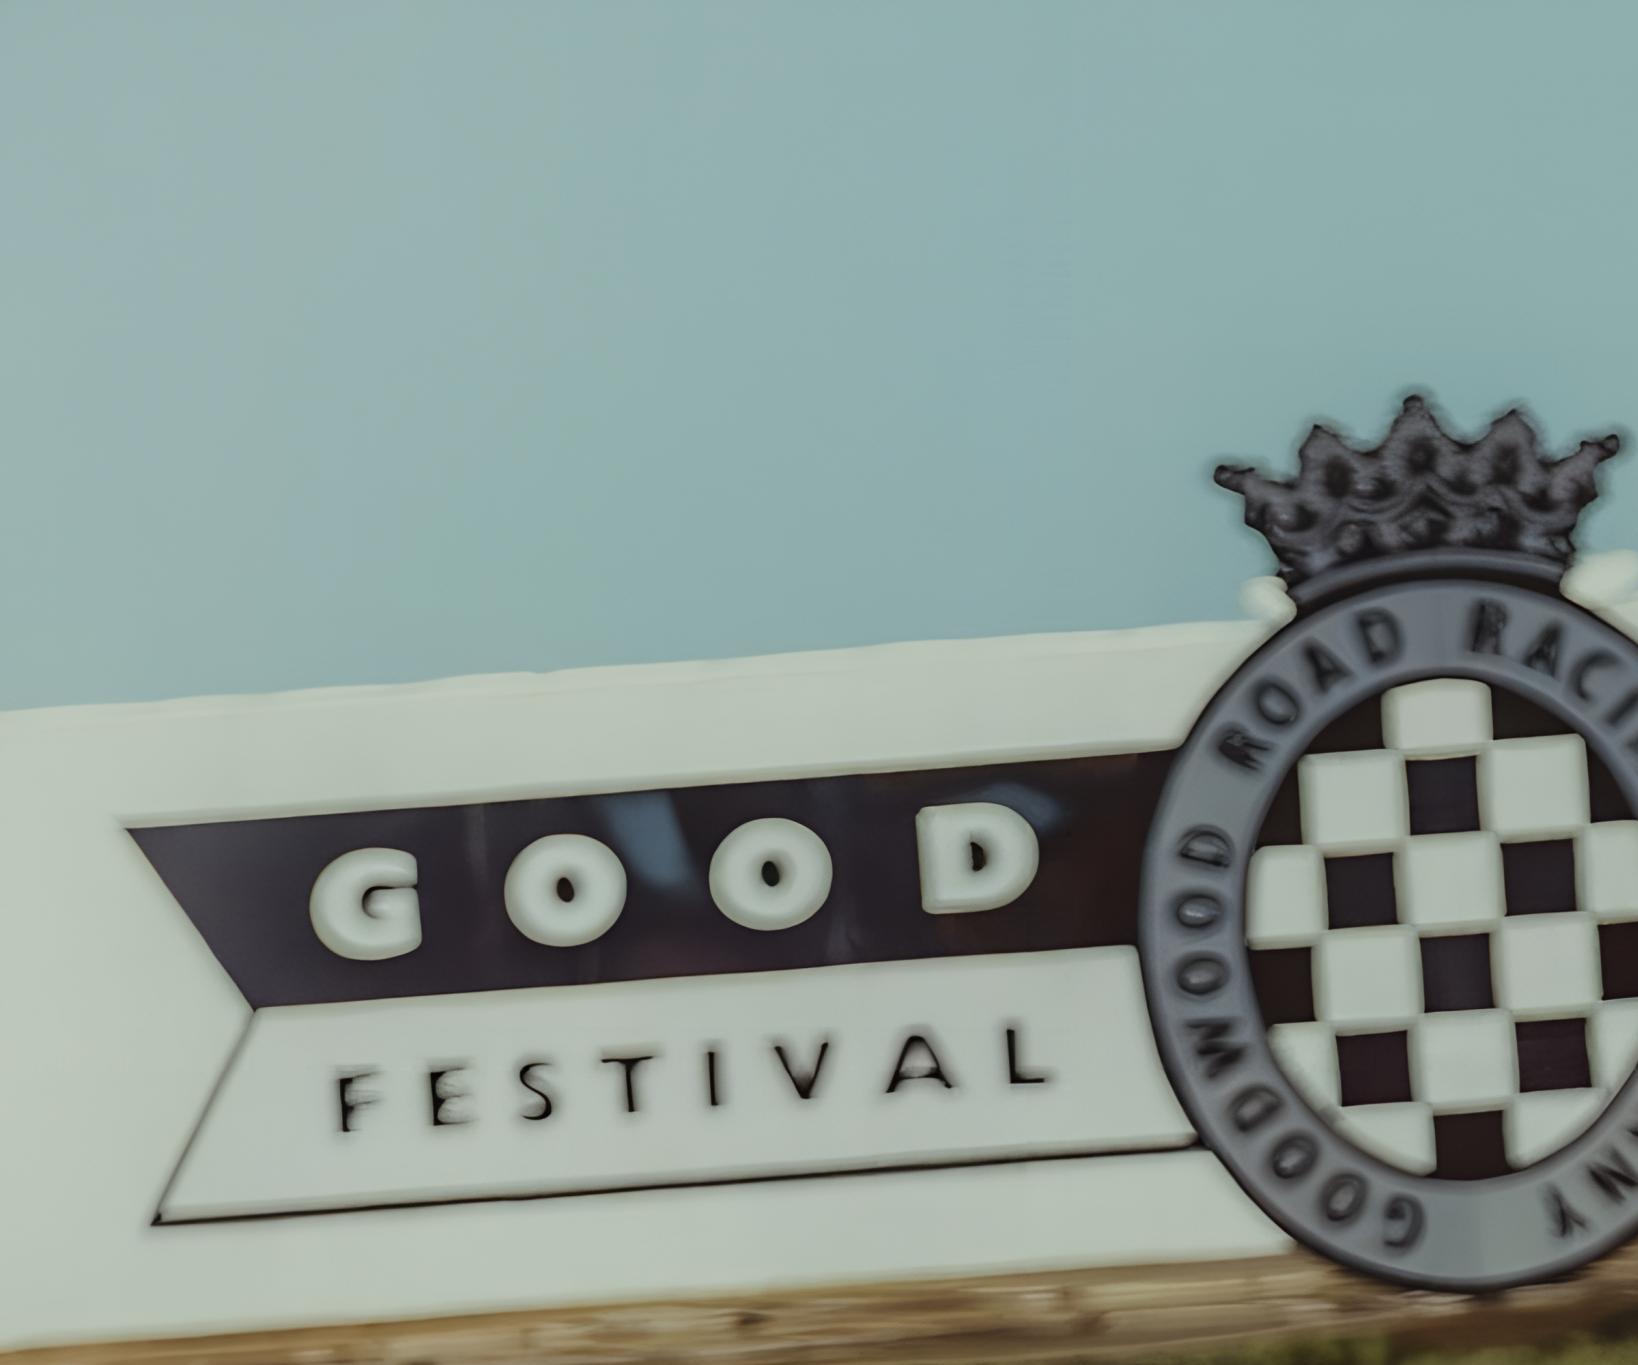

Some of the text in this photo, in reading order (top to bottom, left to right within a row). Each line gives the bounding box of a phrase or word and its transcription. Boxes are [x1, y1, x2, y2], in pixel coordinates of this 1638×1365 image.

[1218, 605, 1400, 773] ROAD
[307, 801, 1040, 961] GOOD
[335, 1027, 1050, 1132] FESTIVAL
[1176, 824, 1427, 1251] GOODWOOD
